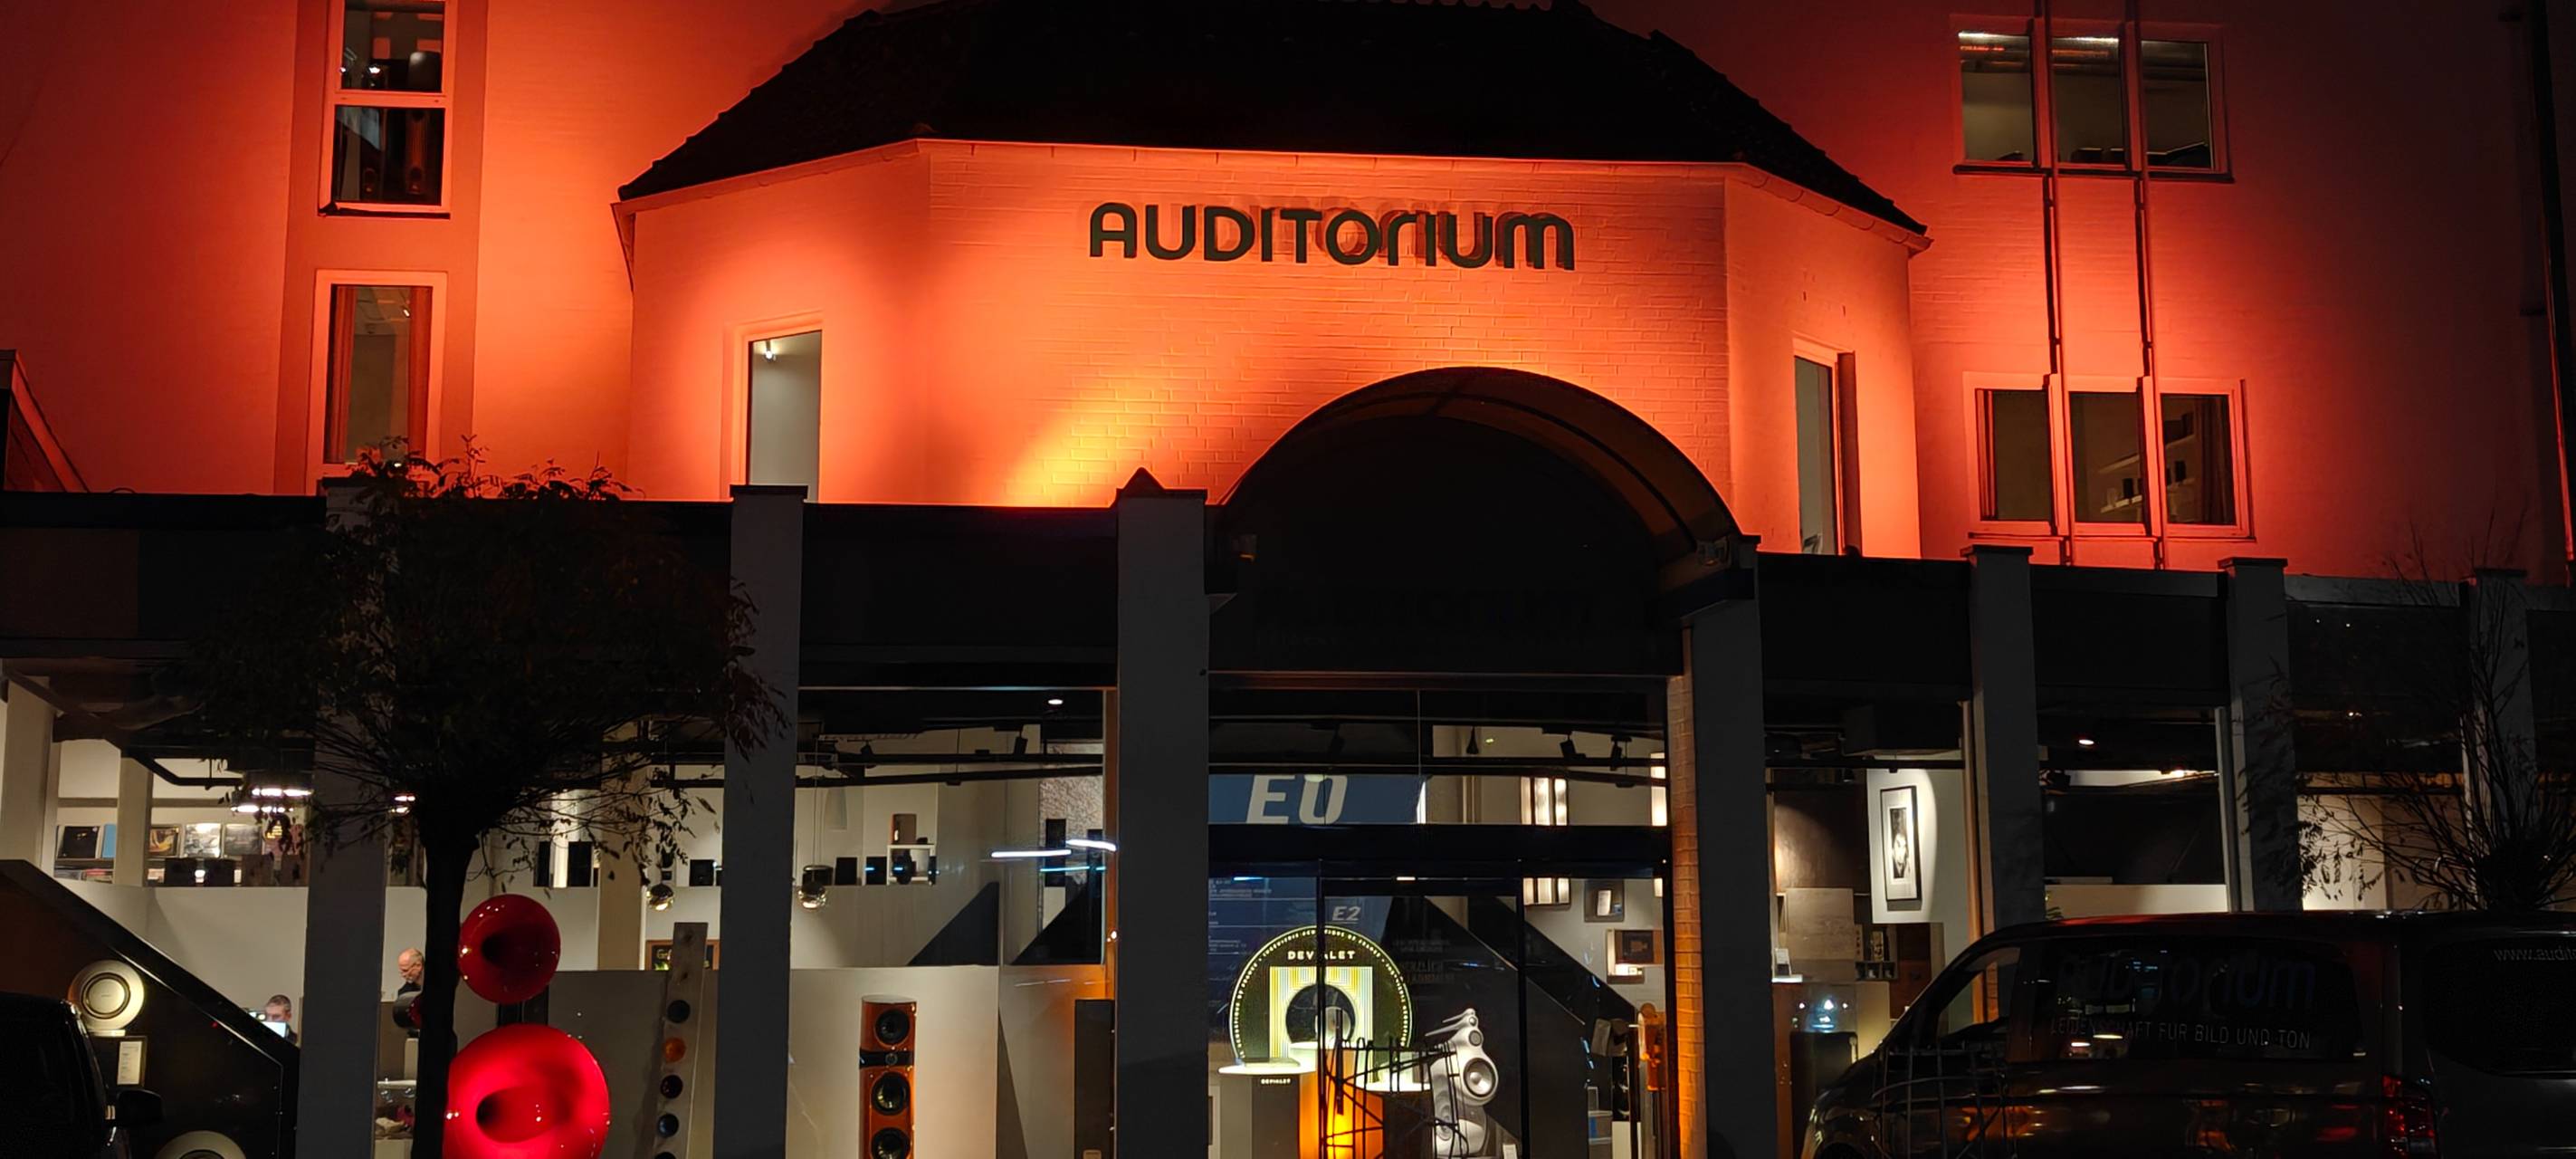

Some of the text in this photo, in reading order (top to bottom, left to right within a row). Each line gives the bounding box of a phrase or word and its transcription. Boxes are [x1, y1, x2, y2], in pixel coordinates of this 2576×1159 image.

[1331, 905, 1361, 921] E2
[1287, 950, 1356, 960] DEVLET
[2194, 1024, 2230, 1044] BILD
[2237, 1027, 2270, 1047] UND
[2277, 1030, 2311, 1049] TON
